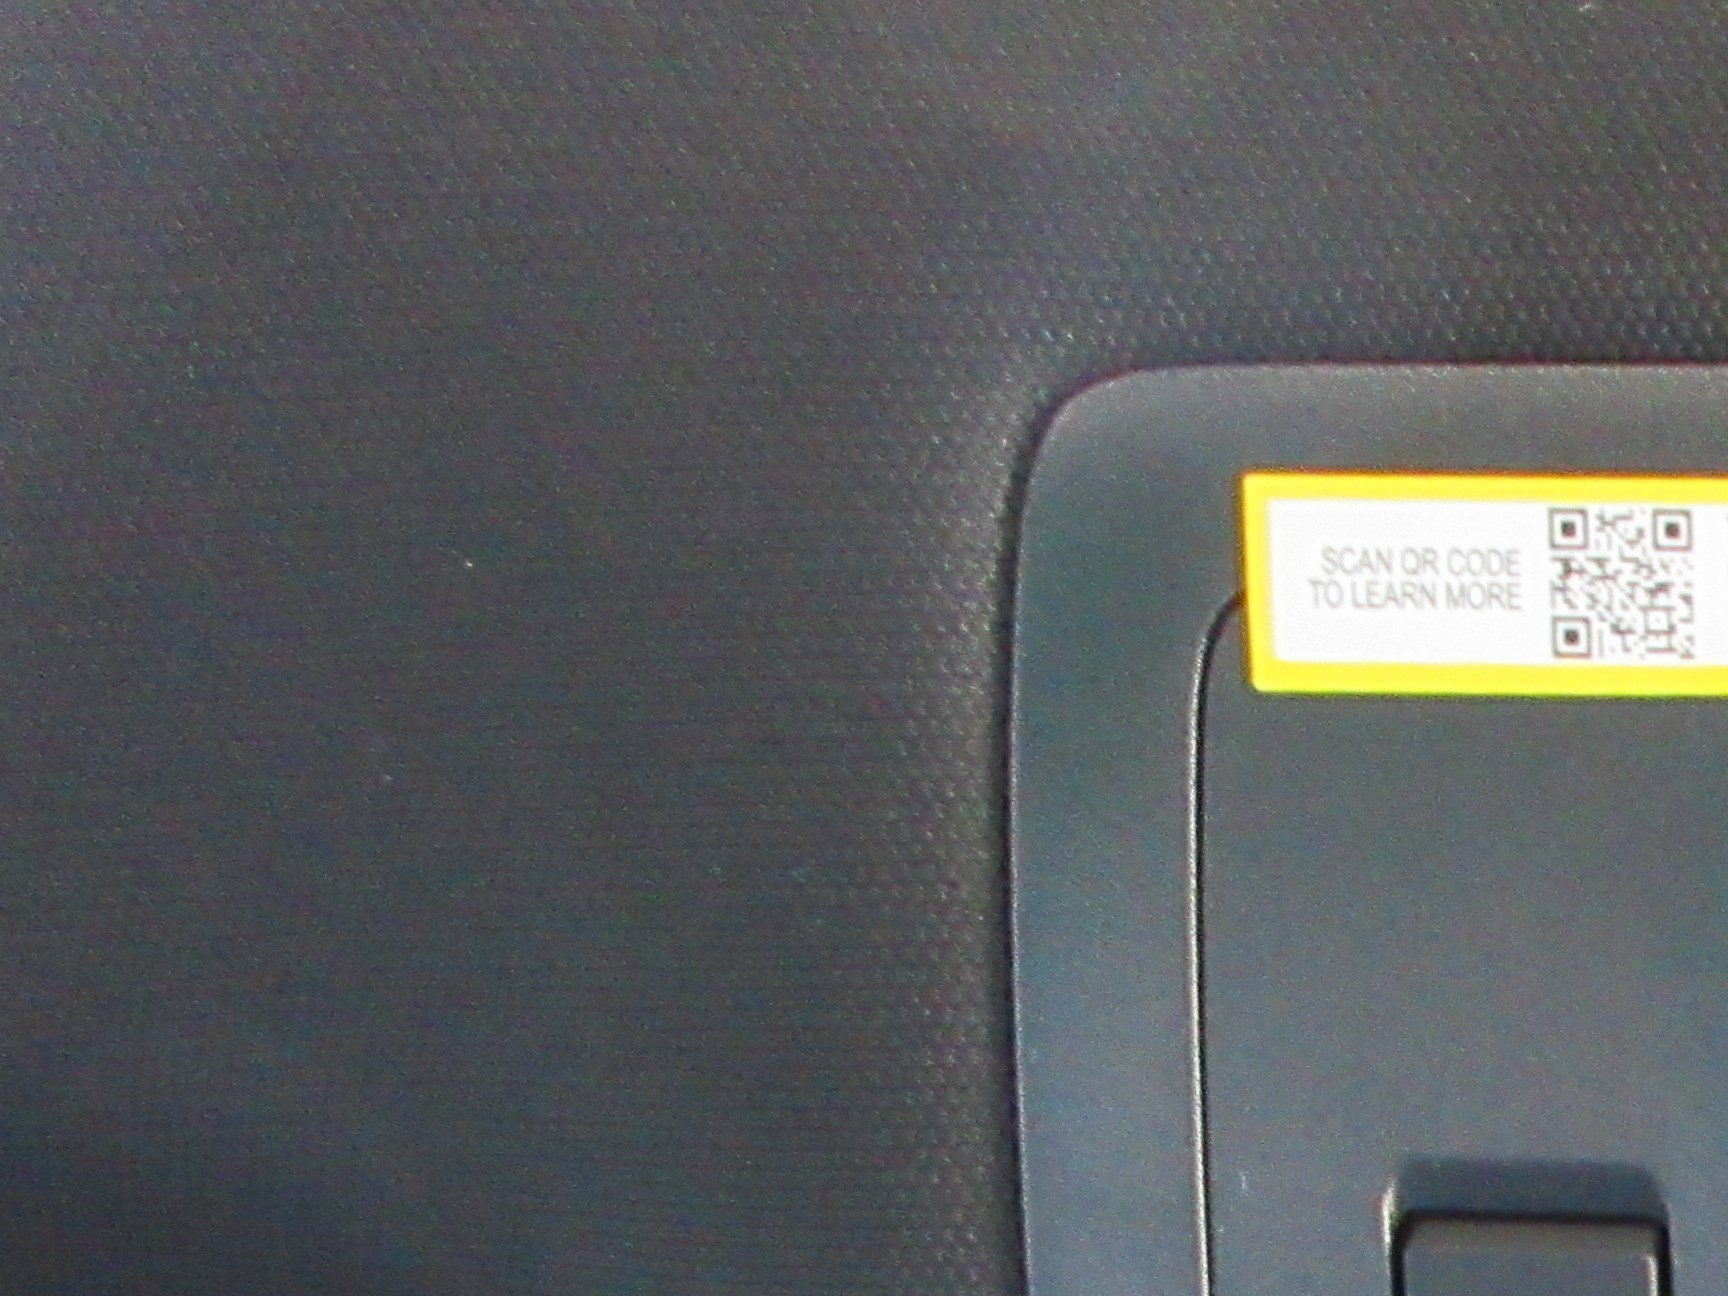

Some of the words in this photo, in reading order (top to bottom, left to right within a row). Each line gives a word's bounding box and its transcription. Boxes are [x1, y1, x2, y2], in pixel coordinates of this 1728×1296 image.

[1320, 546, 1393, 575] SCAN
[1401, 548, 1440, 577] QR
[1446, 548, 1522, 577] CODE
[1309, 579, 1344, 608] TO
[1351, 580, 1439, 610] LEARN
[1445, 581, 1523, 610] MORE
